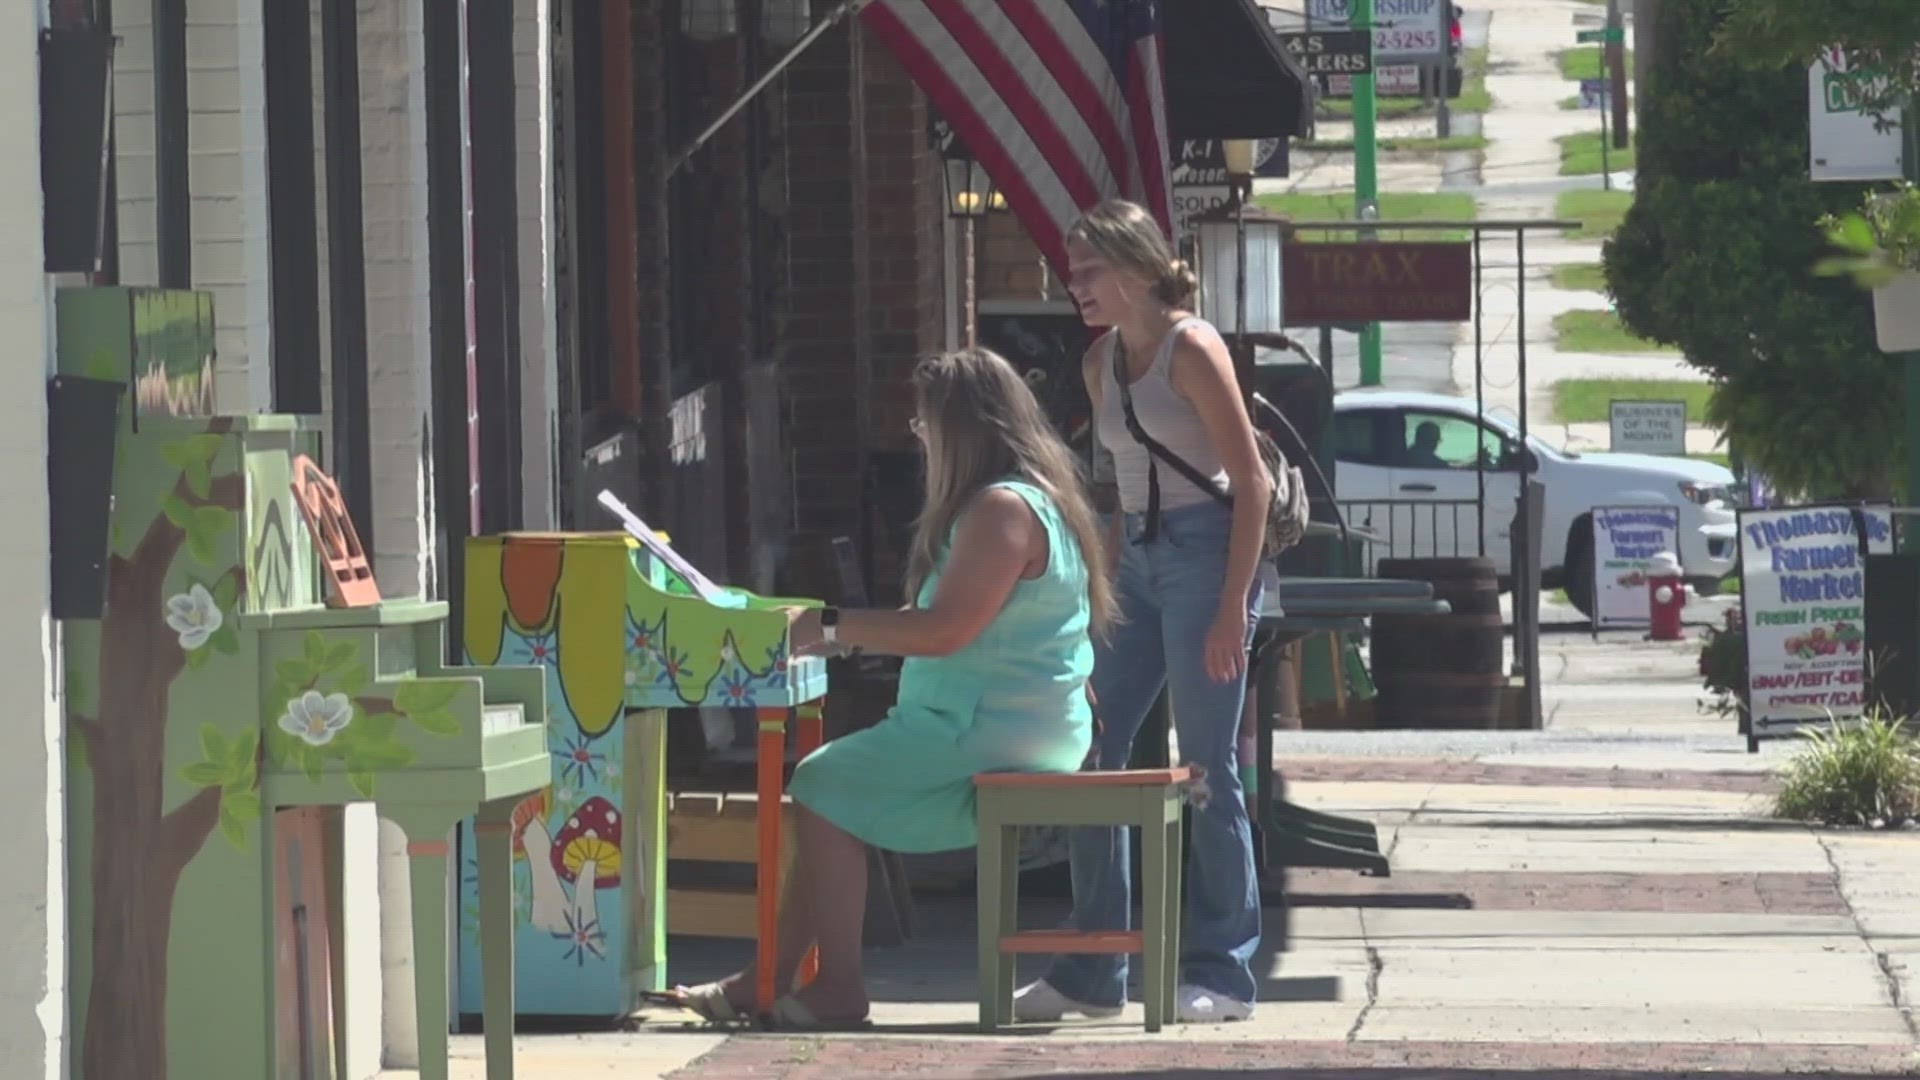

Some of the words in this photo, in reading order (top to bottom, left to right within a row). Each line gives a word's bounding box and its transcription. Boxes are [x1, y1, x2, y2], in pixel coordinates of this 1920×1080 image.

[1375, 30, 1437, 49] 2-5285
[1300, 53, 1366, 71] LERS
[1174, 196, 1224, 212] SOLD
[1304, 251, 1423, 285] TRAX
[1623, 431, 1674, 442] MONTH
